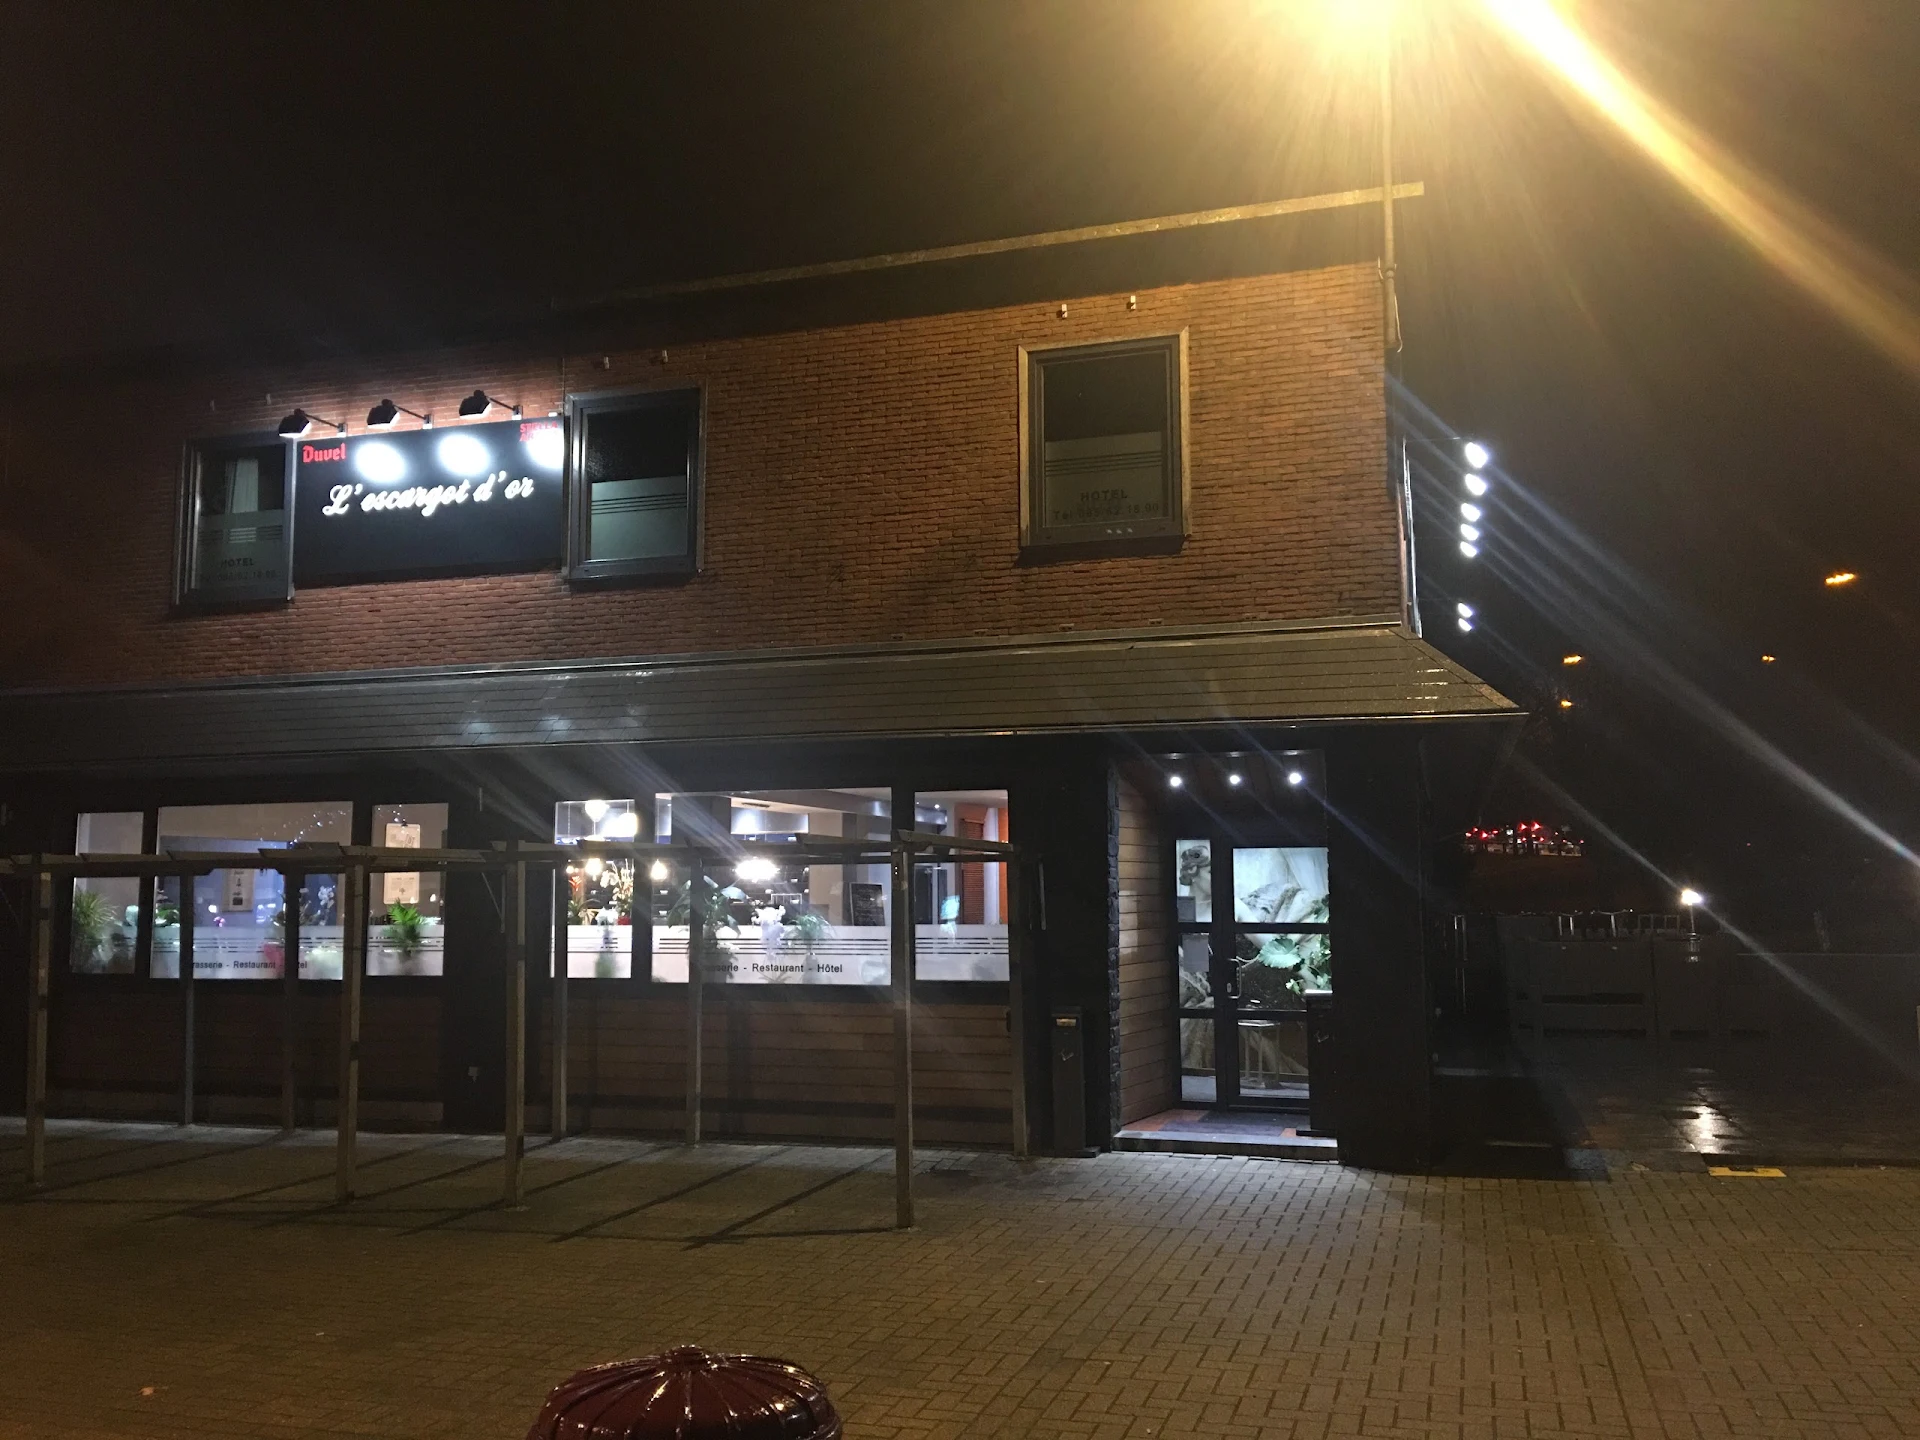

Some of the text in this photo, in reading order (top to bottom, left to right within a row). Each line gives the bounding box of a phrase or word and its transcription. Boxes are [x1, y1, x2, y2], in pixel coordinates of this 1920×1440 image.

[302, 442, 346, 463] Duvel
[322, 470, 535, 517] L'escargot d'or
[1080, 489, 1128, 502] HOTEL
[220, 557, 255, 568] HOTEL
[192, 960, 223, 970] rasserie
[233, 959, 276, 969] Restaurant
[752, 962, 804, 973] Restaurant
[816, 962, 843, 974] Hôtel
